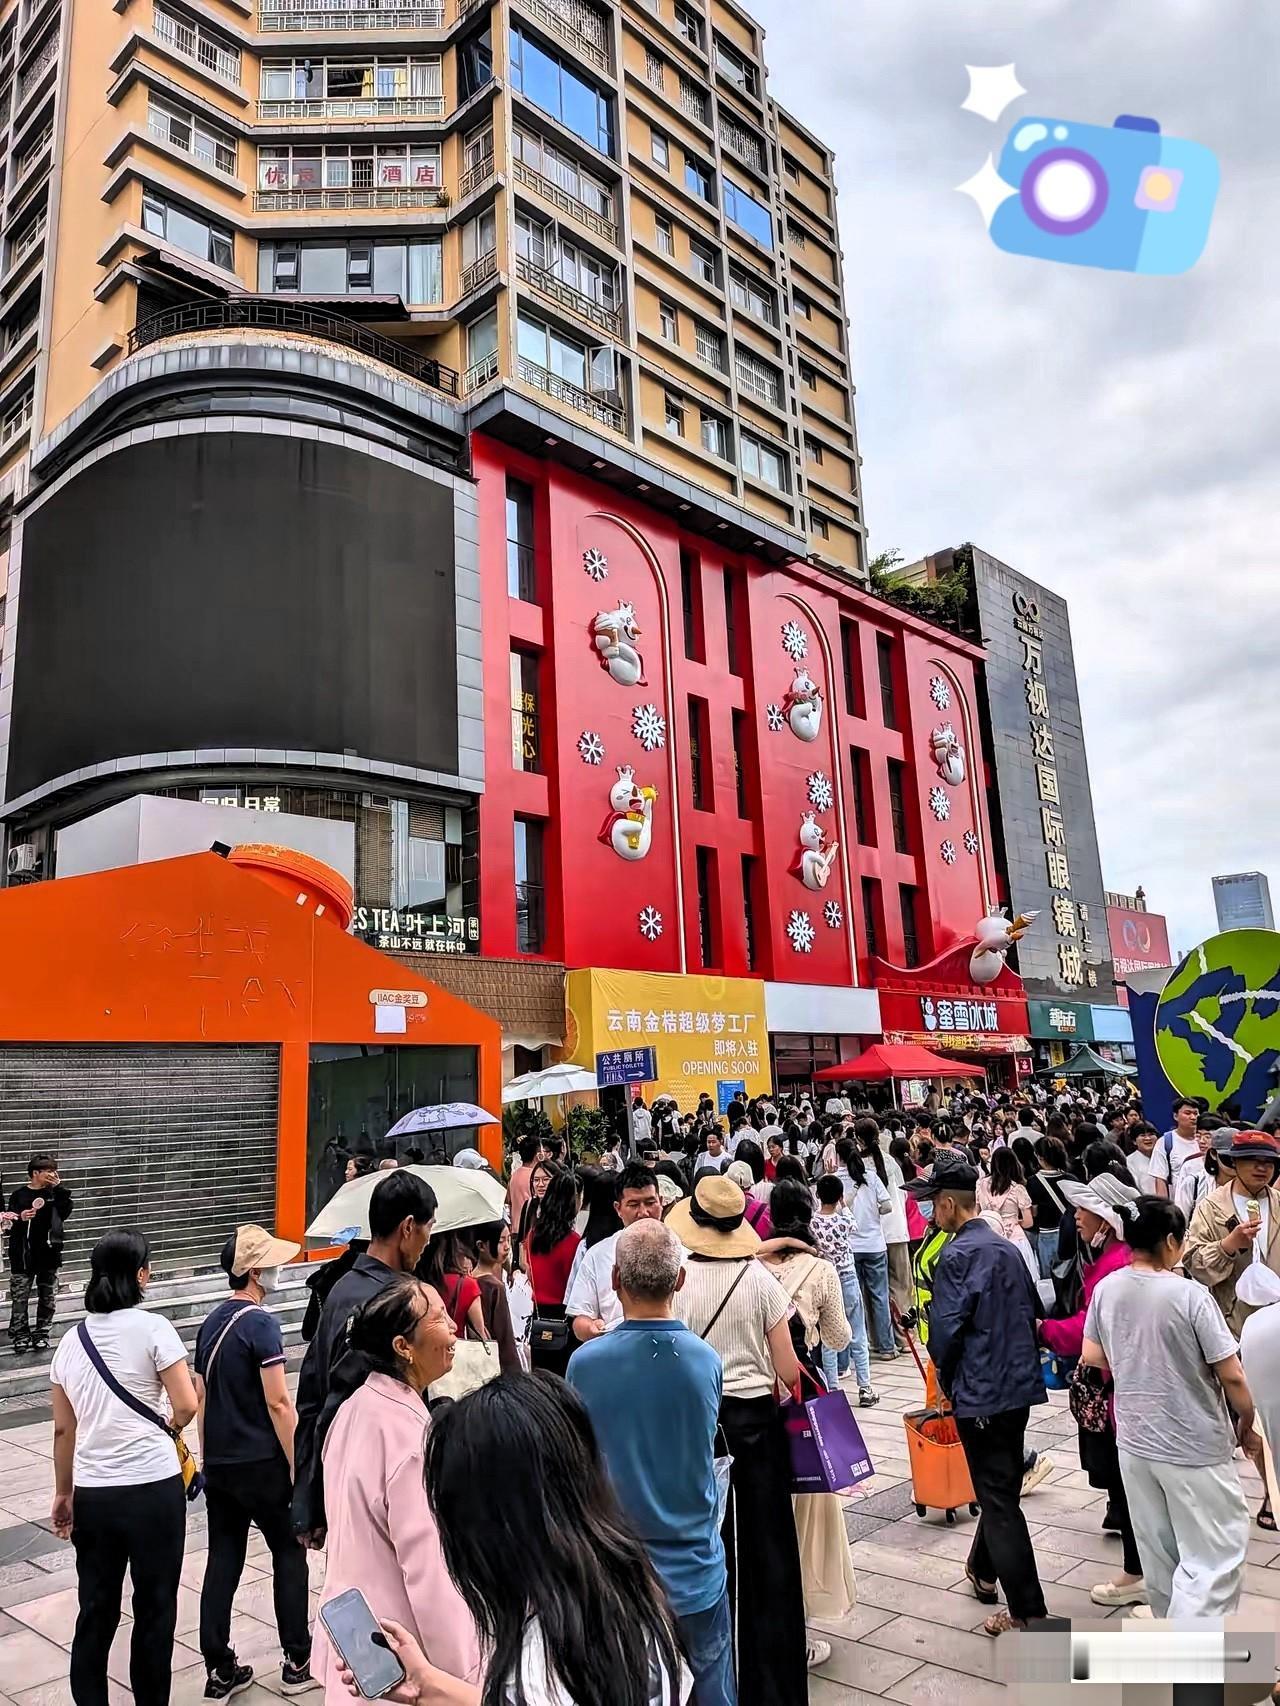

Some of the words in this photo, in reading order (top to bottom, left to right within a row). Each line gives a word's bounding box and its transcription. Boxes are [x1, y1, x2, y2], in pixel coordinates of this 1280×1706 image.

[382, 165, 435, 183] 酒店
[1020, 635, 1084, 985] 万视达国际眼镜城
[372, 908, 400, 933] TEA
[406, 913, 466, 939] 叶上河
[378, 935, 422, 950] 茶山不远
[424, 938, 466, 953] 就在杯中
[606, 1008, 757, 1034] 云南金桔超级梦工厂
[937, 999, 999, 1032] 蜜雪冰城
[713, 1039, 759, 1057] 即将入驻
[601, 1050, 645, 1066] 公共厕所
[622, 1061, 645, 1069] TOILETS
[682, 1060, 729, 1076] OPENING
[731, 1060, 760, 1075] SOON
